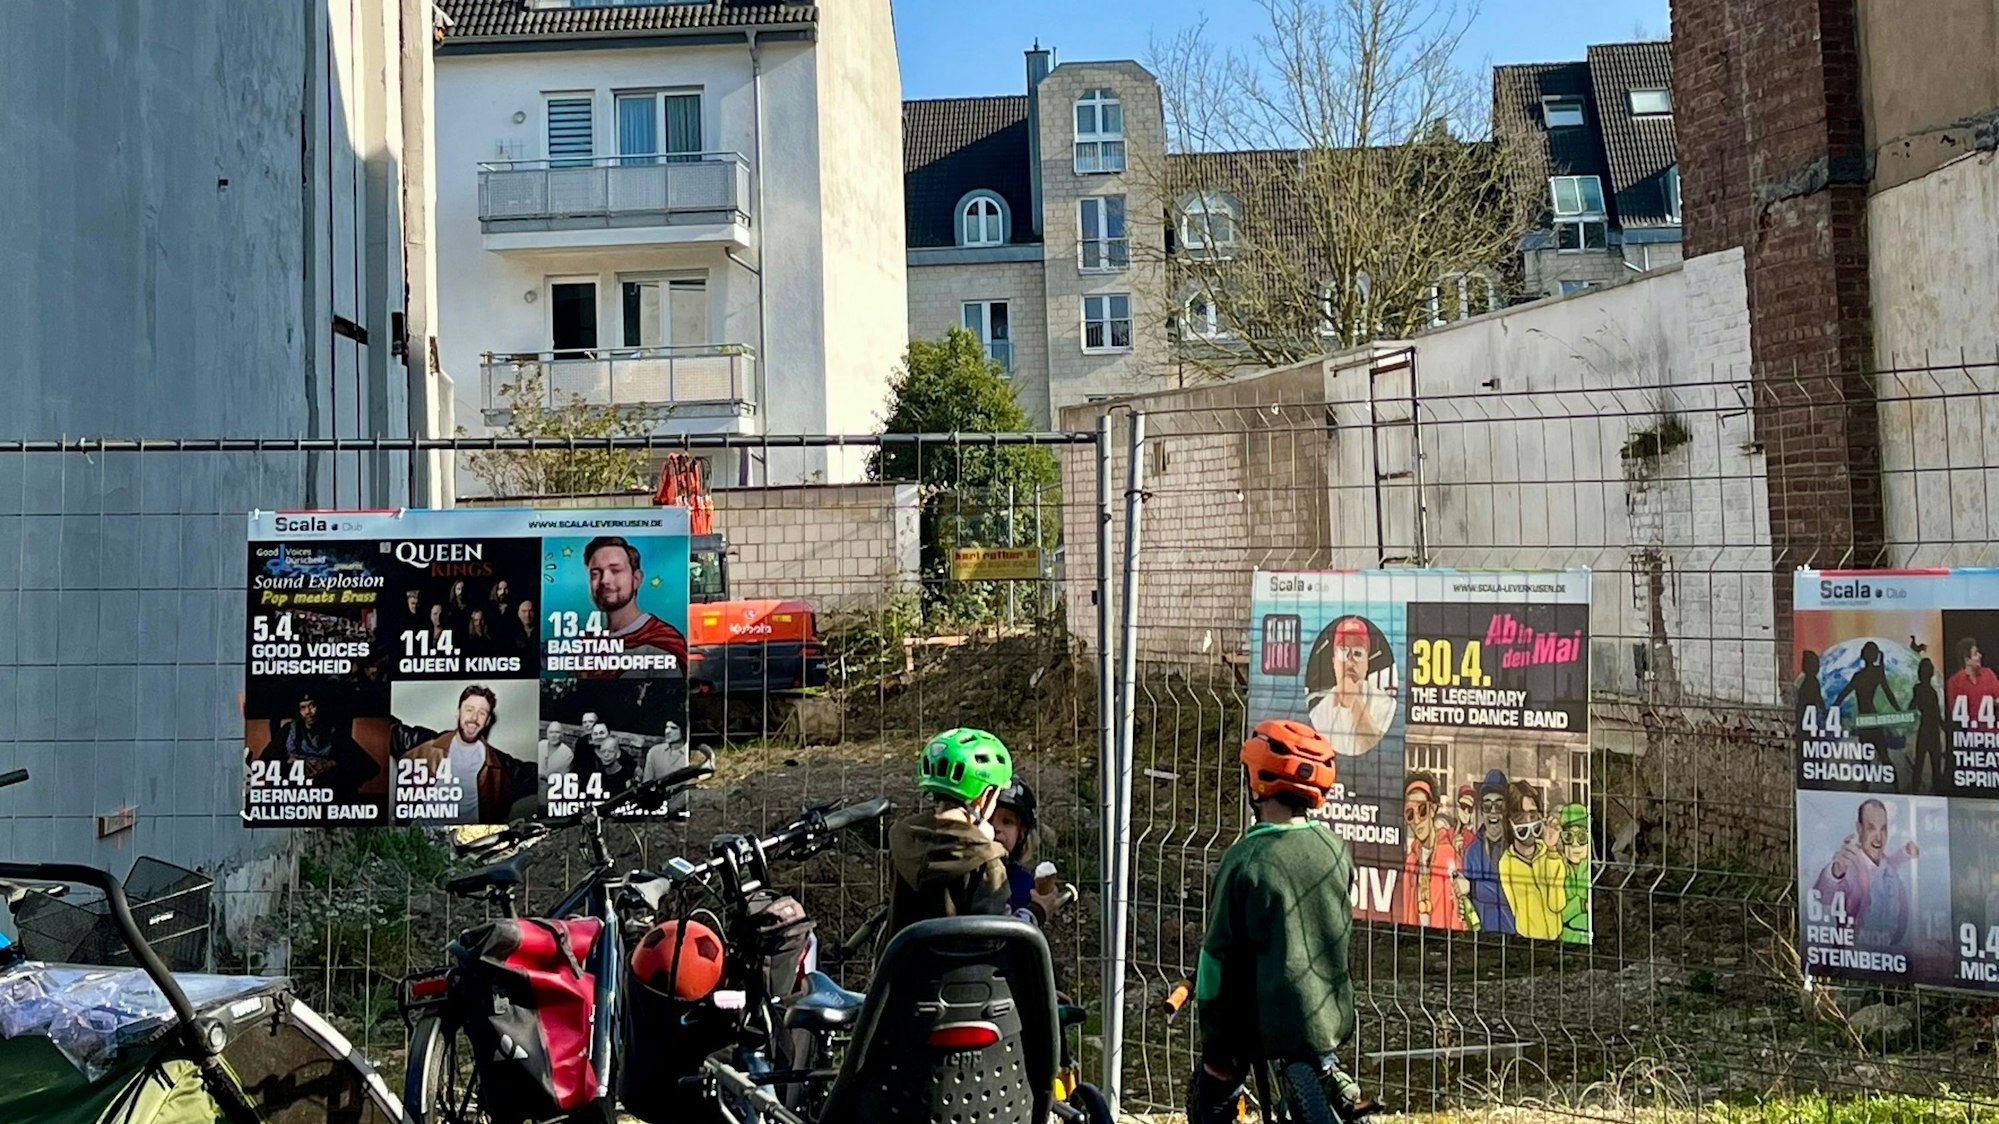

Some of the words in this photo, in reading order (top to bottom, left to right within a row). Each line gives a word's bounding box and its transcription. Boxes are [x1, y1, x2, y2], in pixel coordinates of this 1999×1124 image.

[275, 517, 327, 532] Scala
[342, 522, 363, 532] Club
[528, 519, 663, 529] WWW.SCALA-LEVERKUSEN.DE
[256, 547, 279, 557] Good
[285, 548, 312, 556] Voices
[395, 541, 483, 569] QUEEN
[431, 562, 493, 577] KINGS
[253, 574, 303, 590] Sound
[307, 573, 384, 589] Explosion
[1270, 576, 1305, 592] Scala
[1453, 584, 1567, 593] WWW.SCALA-LEVERKUSEN.DE
[1820, 580, 1871, 599] Scala
[260, 590, 288, 605] Pop
[293, 593, 335, 604] meets
[341, 590, 376, 604] Brass
[253, 614, 300, 642] 5.4.
[548, 610, 611, 637] 13.4.
[729, 623, 772, 635] Kubota
[1485, 613, 1517, 646] Ab
[1517, 624, 1534, 644] in
[252, 643, 302, 658] GOOD
[306, 641, 370, 657] VOICES
[399, 629, 461, 656] 11.4.
[547, 639, 625, 654] BASTIAN
[1502, 648, 1531, 668] den
[1533, 629, 1582, 665] Mai
[252, 657, 352, 675] DÜRSCHEID
[399, 657, 459, 673] QUEEN
[465, 656, 521, 672] KINGS
[547, 655, 677, 671] BIELENDORFER
[1412, 639, 1492, 688] 30.4.
[1410, 687, 1438, 705] THE
[1441, 688, 1527, 708] LEGENDARY
[1410, 706, 1465, 723] GHETTO
[1468, 708, 1519, 726] DANCE
[1523, 710, 1569, 729] BAND
[1802, 705, 1849, 738] 4.4.
[1952, 695, 1999, 729] 4.4
[1952, 731, 1999, 748] IMPR
[1803, 741, 1876, 760] MOVING
[250, 760, 314, 787] 24.4.
[397, 758, 461, 786] 25.4.
[1803, 761, 1895, 783] SHADOWS
[249, 788, 334, 803] BERNARD
[396, 786, 463, 802] MARCO
[547, 772, 611, 800] 26.4.
[1326, 782, 1345, 800] ER
[250, 805, 322, 820] ALLISON
[327, 804, 379, 819] BAND
[395, 803, 459, 819] GIANNI
[1807, 888, 1854, 924] 6.4.
[1807, 924, 1855, 947] RENÉ
[1807, 946, 1907, 973] STEINBERG
[1960, 961, 1999, 982] MIC
